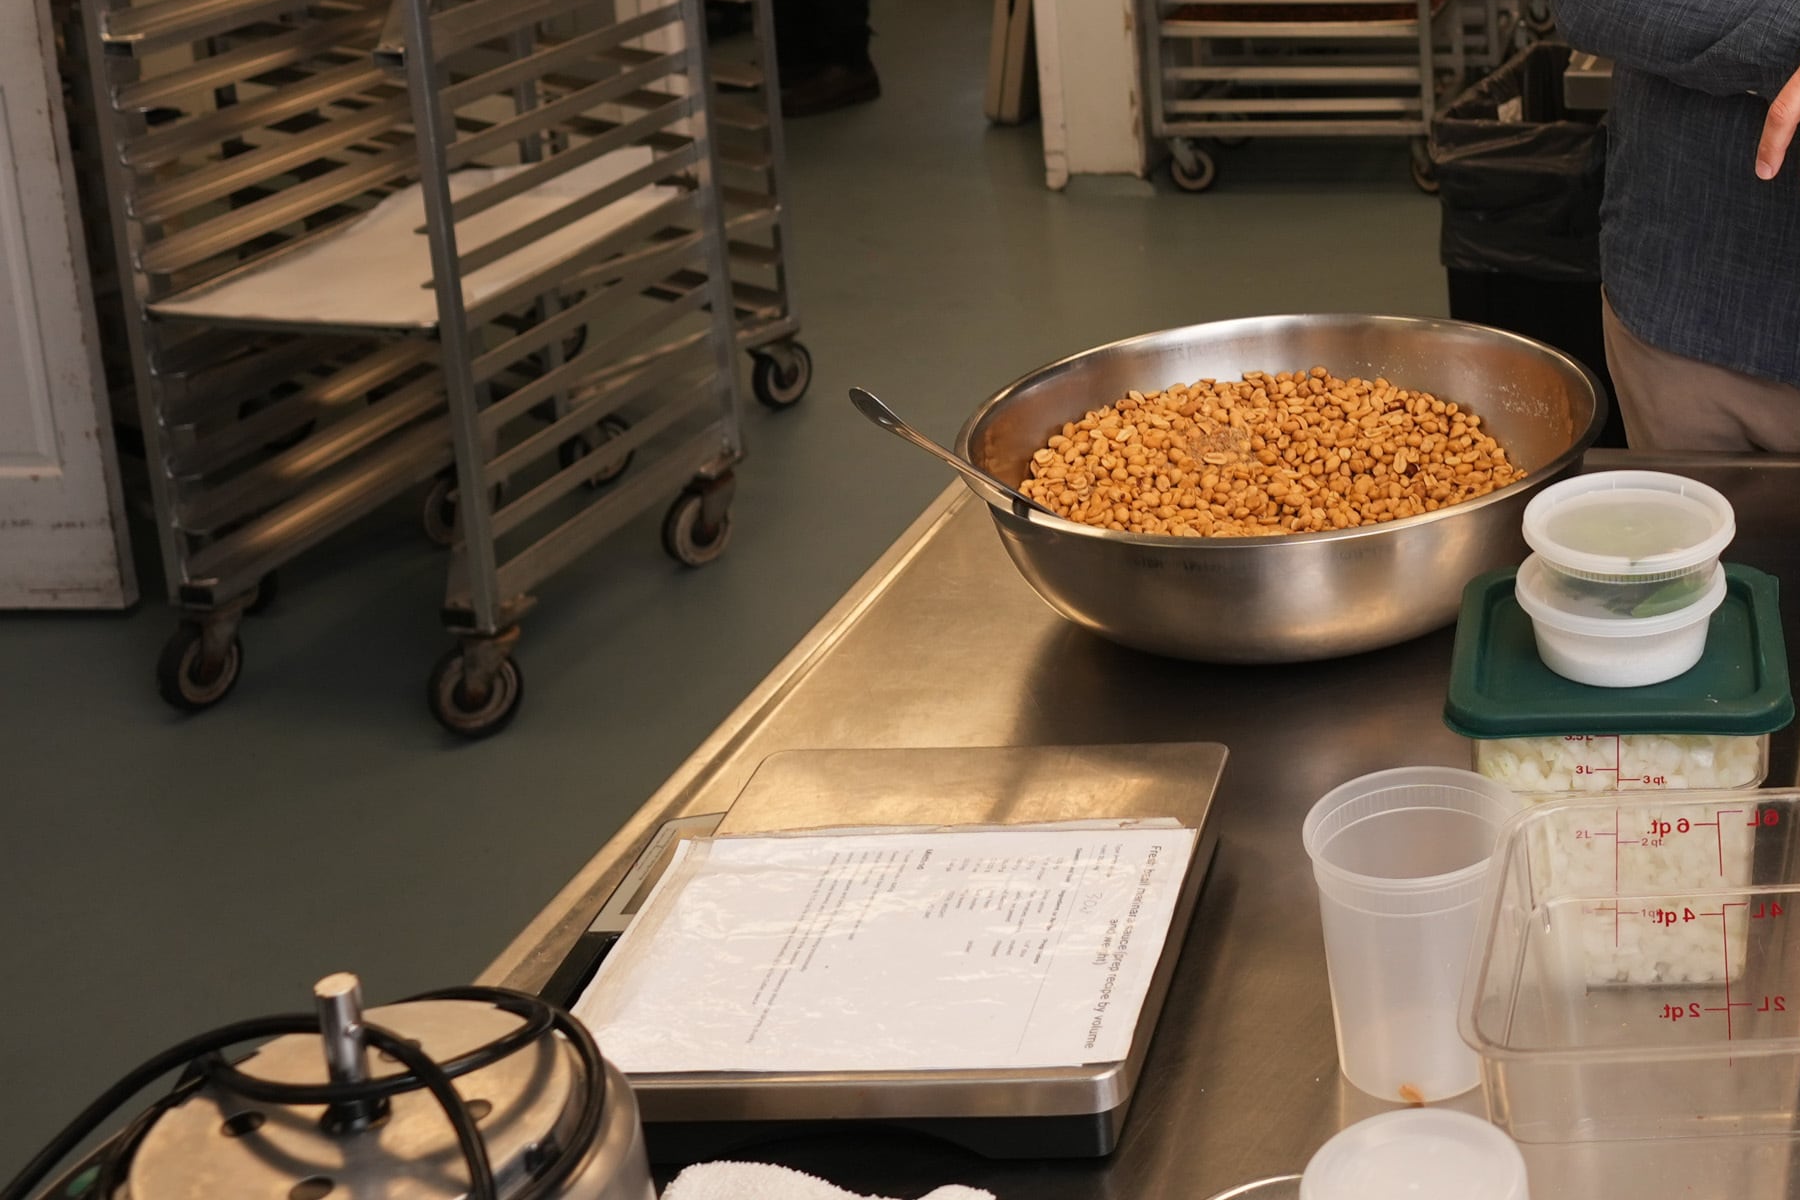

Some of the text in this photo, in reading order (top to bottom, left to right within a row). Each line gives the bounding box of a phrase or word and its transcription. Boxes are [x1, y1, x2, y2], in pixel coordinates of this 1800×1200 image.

[1576, 765, 1593, 775] 3 L
[1643, 775, 1651, 784] 3
[1576, 831, 1583, 839] 2
[1641, 838, 1648, 846] 2
[1100, 973, 1116, 1000] recipe
[1094, 1001, 1110, 1013] by
[1084, 1015, 1102, 1049] volume
